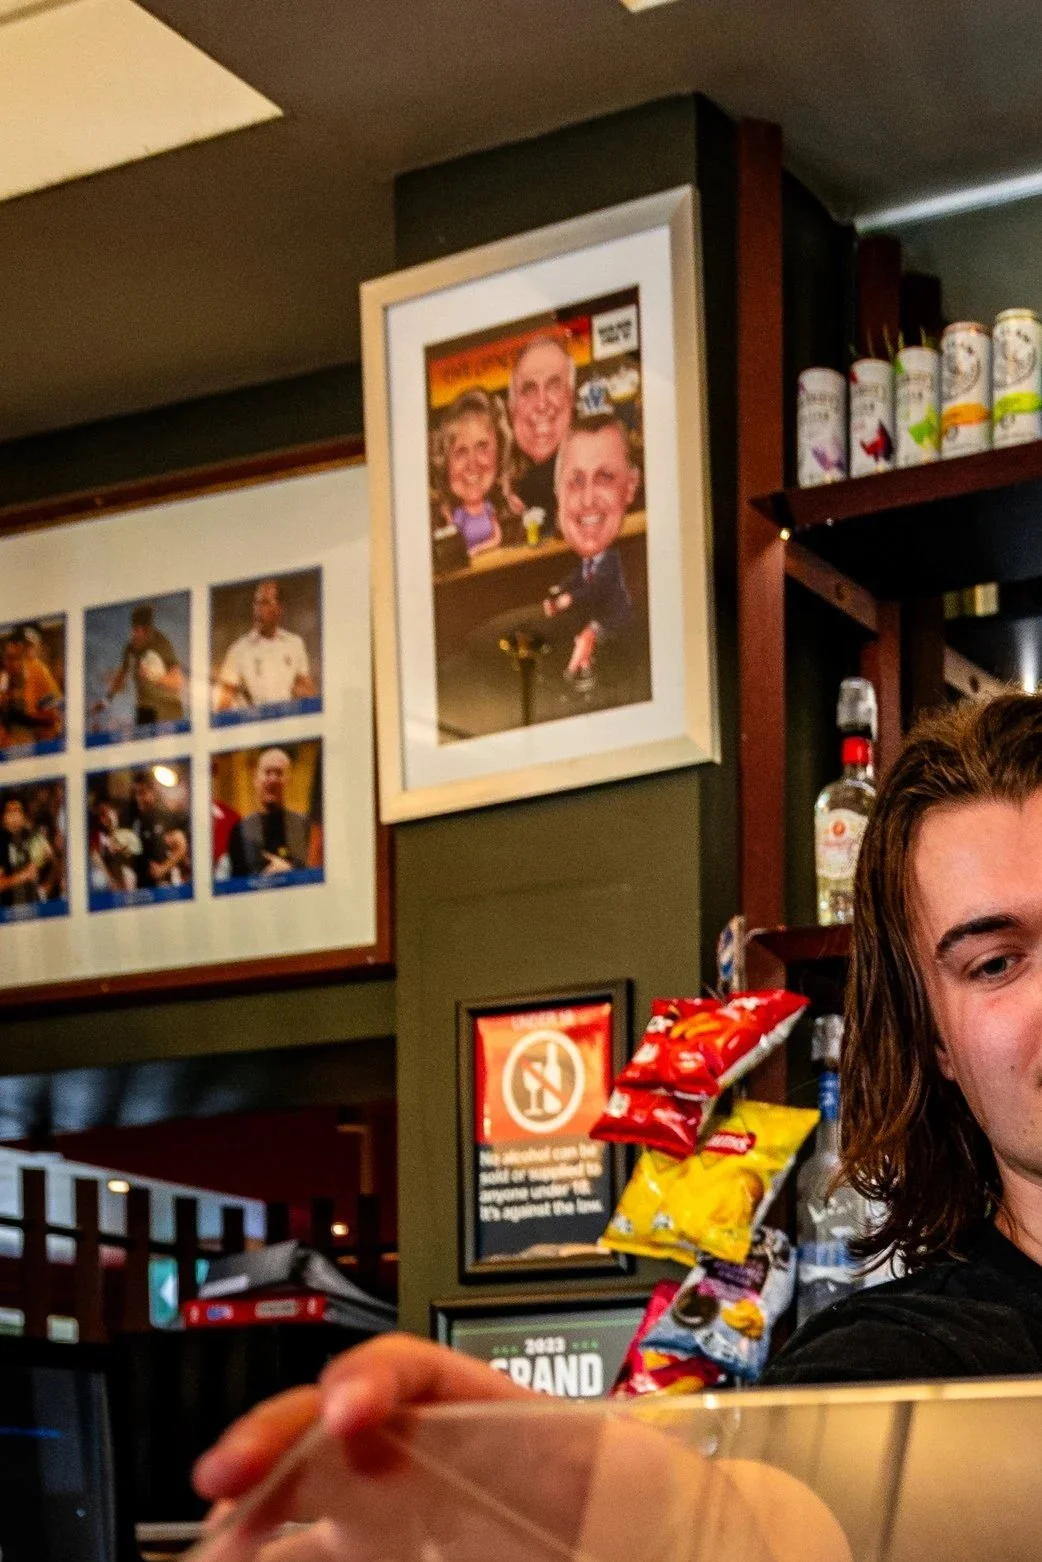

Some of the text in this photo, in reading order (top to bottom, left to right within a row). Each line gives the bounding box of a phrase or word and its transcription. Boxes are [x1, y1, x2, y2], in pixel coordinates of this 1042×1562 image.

[501, 1146, 552, 1166] alcohol
[552, 1198, 576, 1217] the
[488, 1352, 603, 1398] RAND
